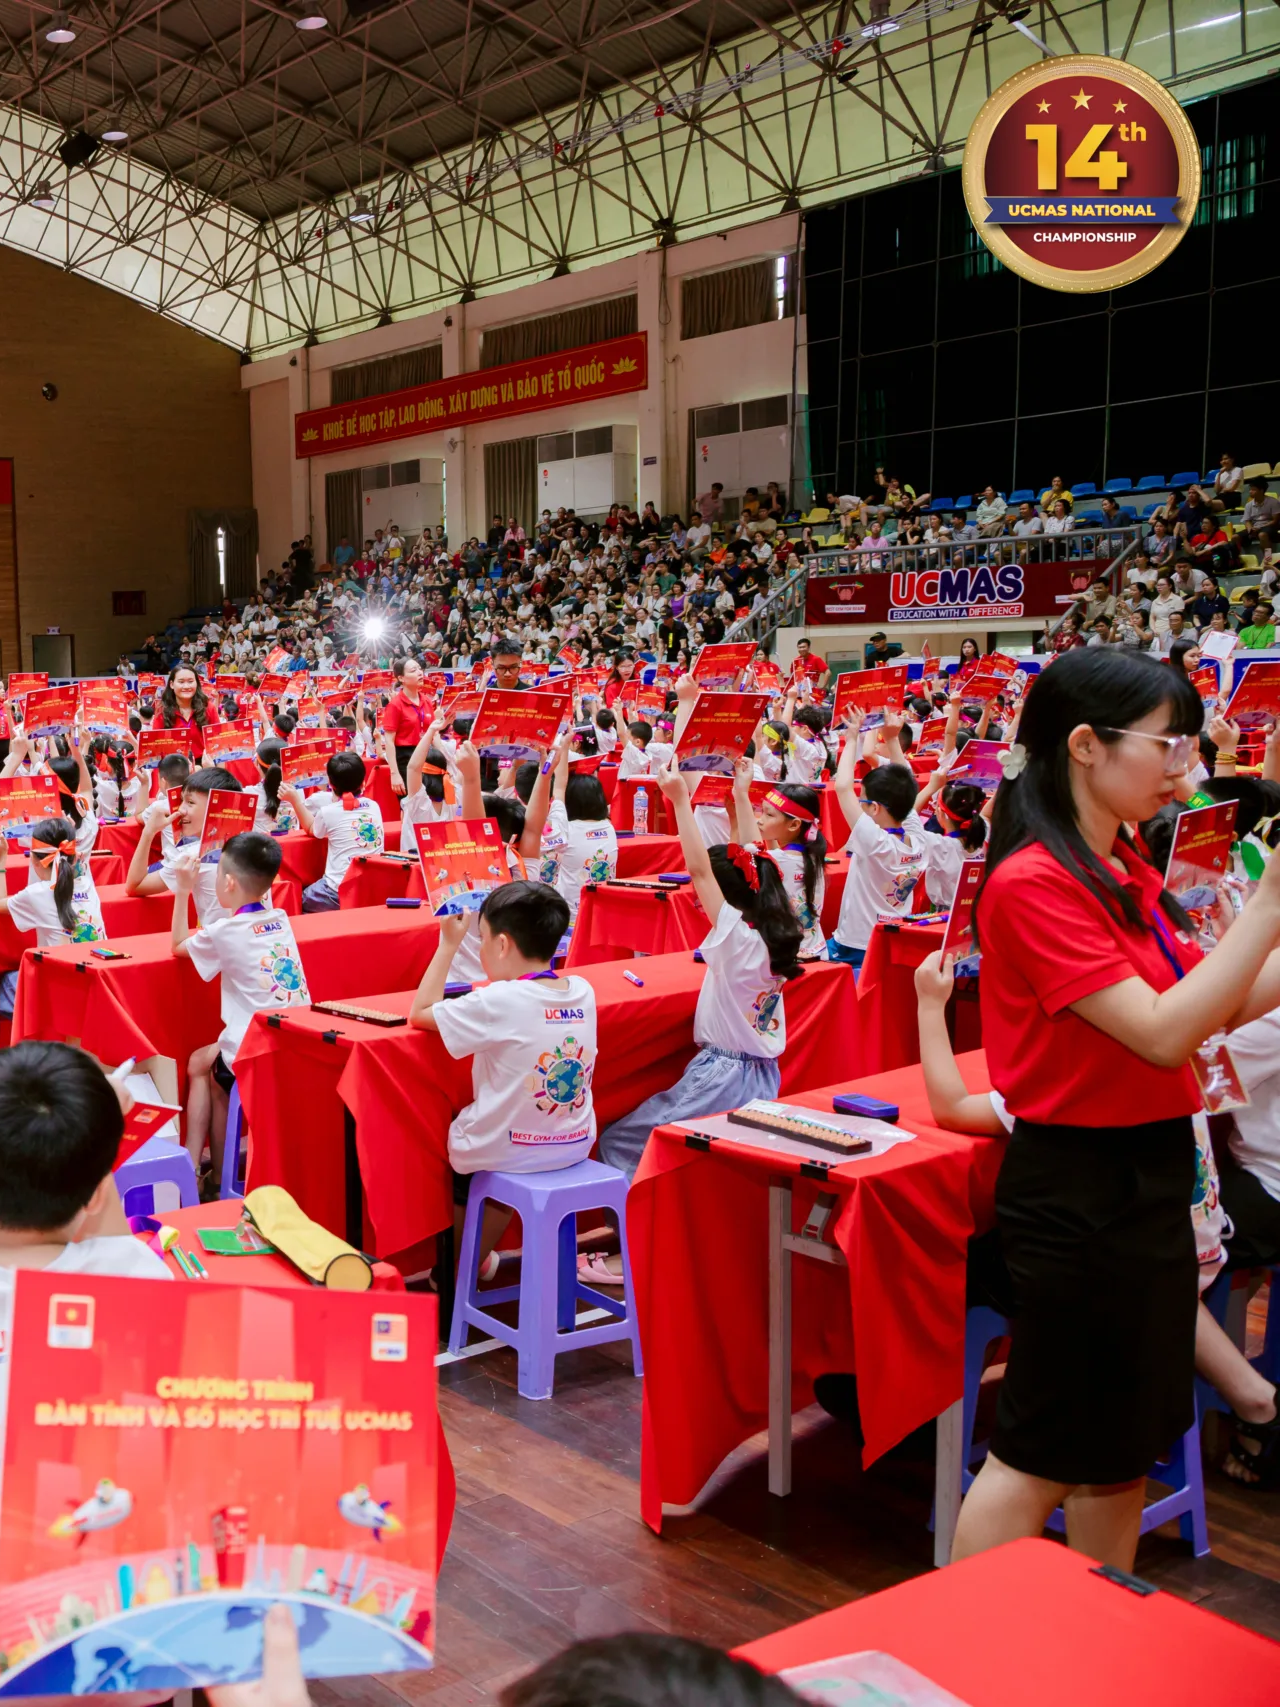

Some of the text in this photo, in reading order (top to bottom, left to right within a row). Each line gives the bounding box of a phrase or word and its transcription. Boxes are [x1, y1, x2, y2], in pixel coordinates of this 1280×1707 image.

[359, 413, 377, 437] HỌC
[398, 405, 416, 425] LAO
[448, 389, 468, 414] XÂY
[470, 388, 499, 413] DỰNG
[500, 380, 515, 403] VÀ
[516, 371, 539, 399] BẢO
[541, 373, 554, 399] VỆ
[557, 360, 571, 390] TỔ
[574, 356, 605, 388] QUỐC
[890, 565, 1023, 606] UCMAS
[892, 605, 1020, 620] EDUCATION WITH A DIFFERENCE
[253, 922, 282, 934] UCMAS
[545, 1009, 584, 1020] UCMAS
[513, 1129, 588, 1142] BEST GYM FOR BRAIN
[156, 1375, 313, 1401] CHƯƠNG TRÌNH
[35, 1398, 413, 1435] BÀN TÍNH VÀ SỐ HỌC TRÍ TUỆ UCMAS
